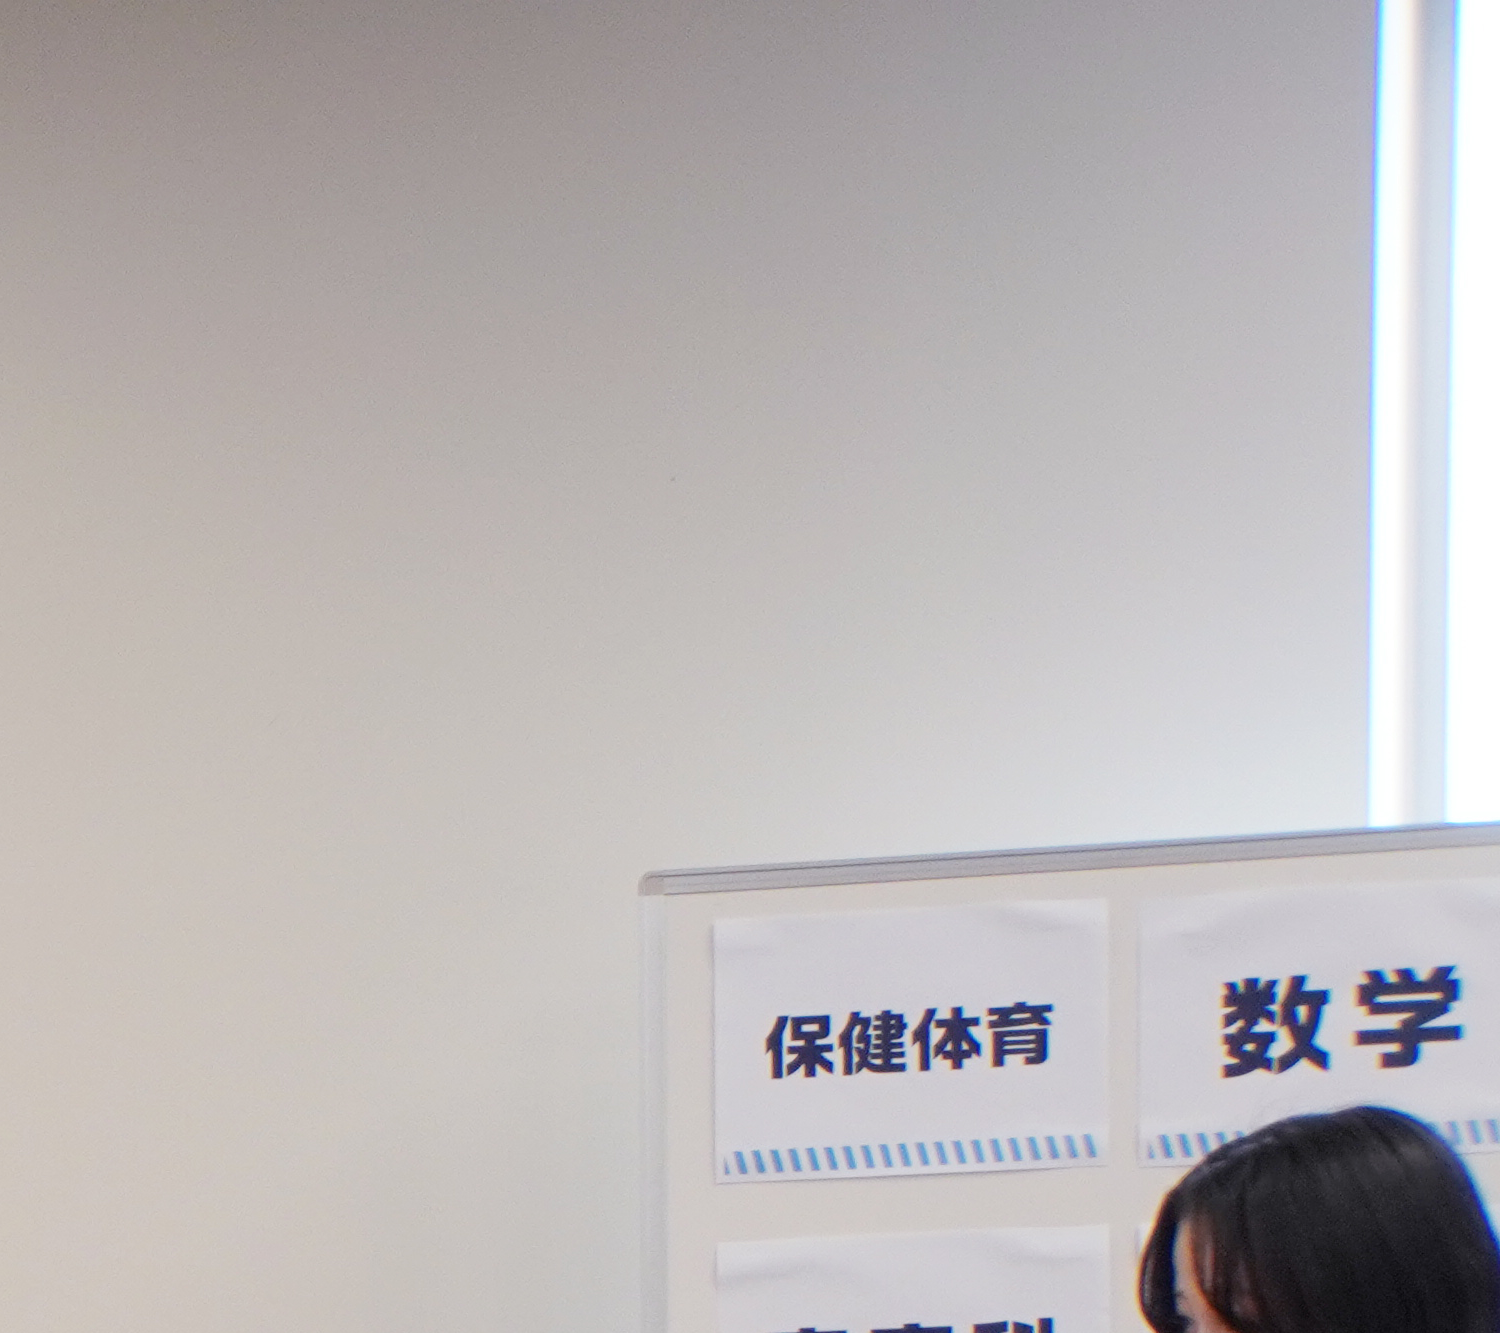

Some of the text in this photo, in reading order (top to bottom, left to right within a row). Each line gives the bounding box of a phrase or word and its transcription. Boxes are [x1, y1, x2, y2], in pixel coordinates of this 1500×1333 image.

[765, 1003, 1054, 1079] 保健体育
[1220, 965, 1464, 1078] 数学
